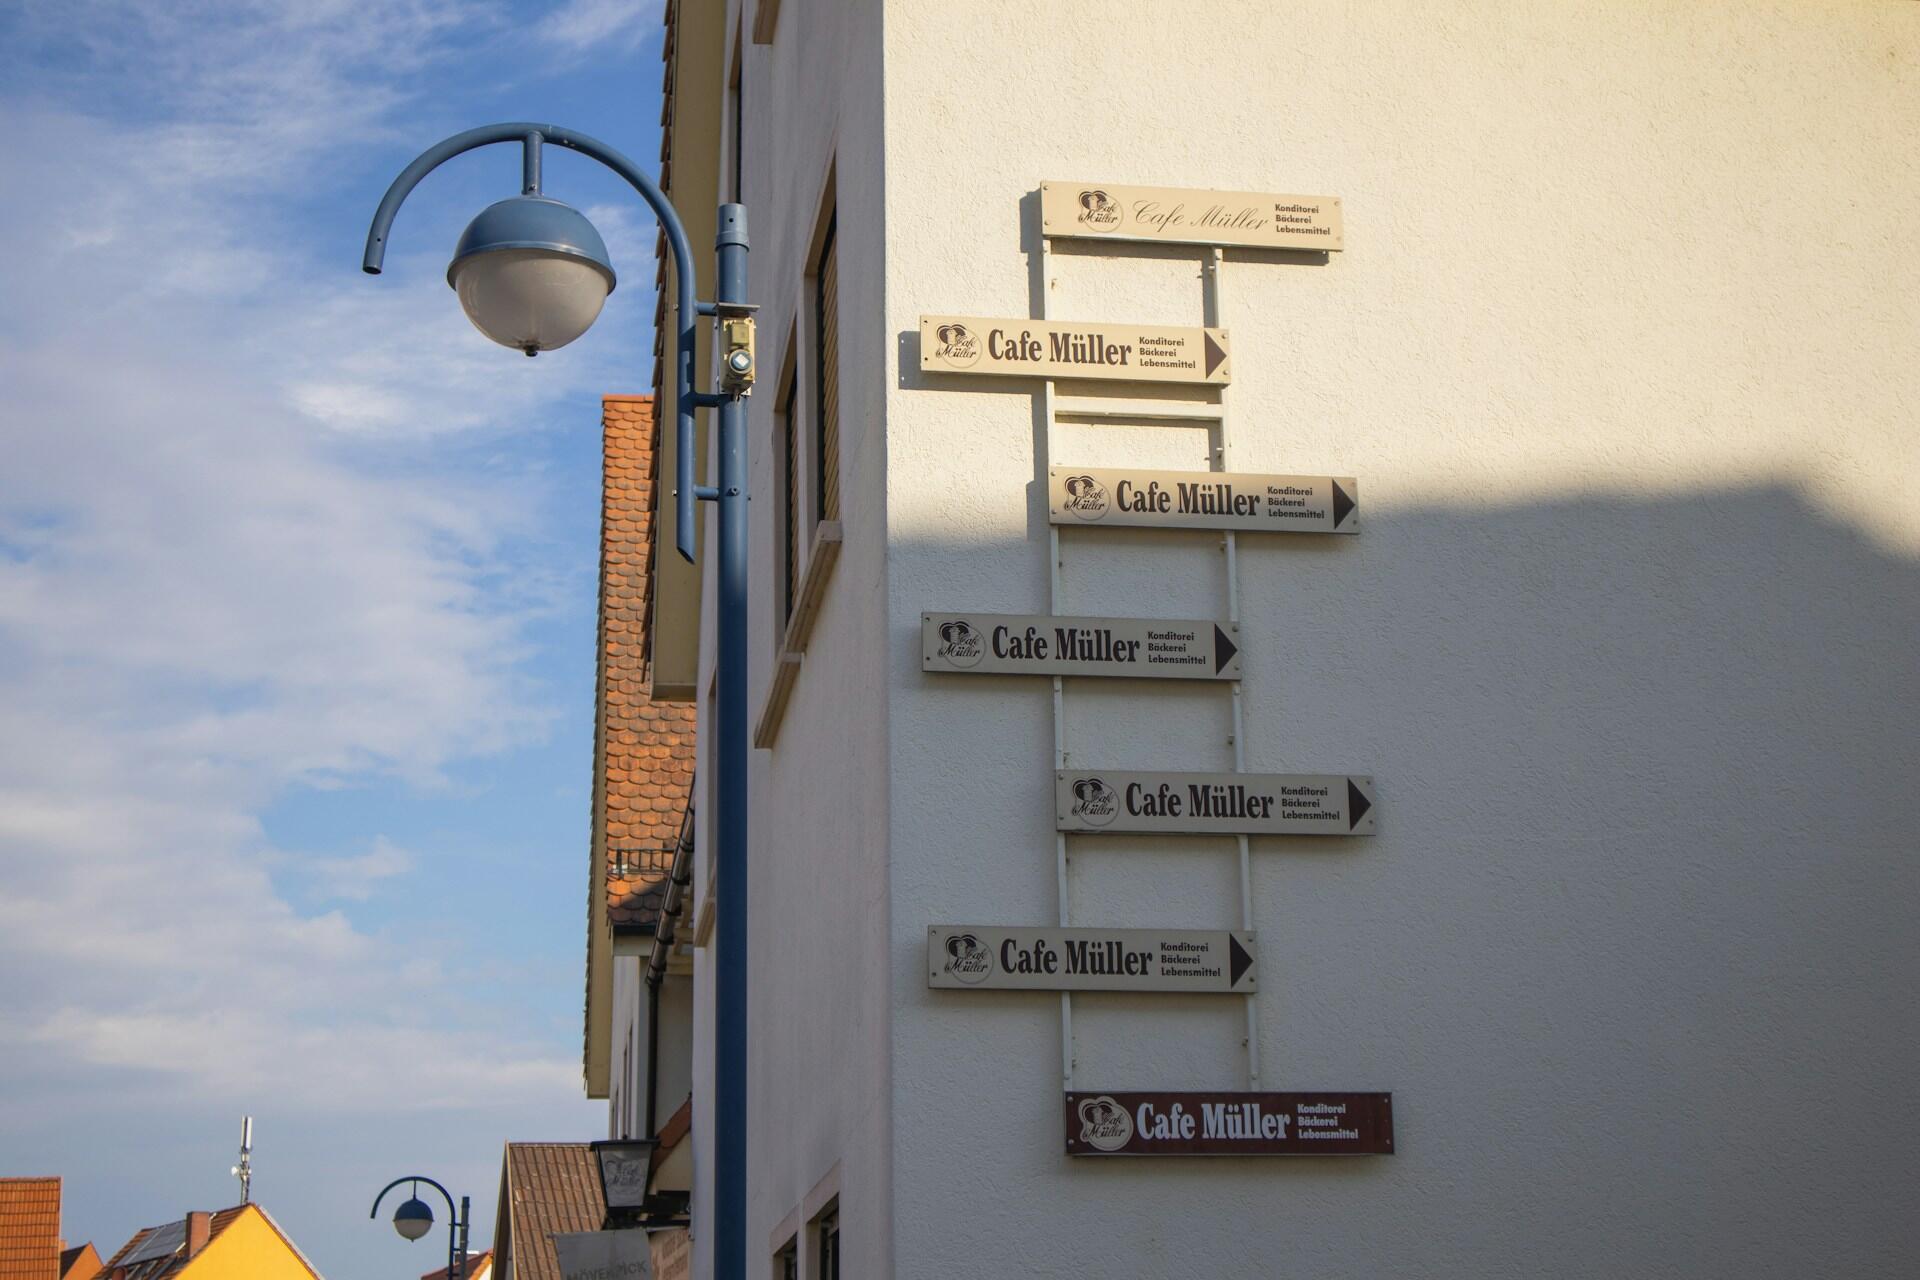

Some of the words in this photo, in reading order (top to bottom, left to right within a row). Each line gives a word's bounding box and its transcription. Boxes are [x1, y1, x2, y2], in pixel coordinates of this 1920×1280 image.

[1275, 204, 1319, 213] Konditorei
[1078, 209, 1118, 224] Müller
[1133, 200, 1184, 232] Cafe
[1190, 206, 1270, 230] Müller
[1275, 215, 1312, 224] Bäckerei
[1276, 226, 1331, 235] Lebensmittel
[1139, 336, 1184, 346] Konditorei
[936, 344, 977, 359] Müller
[988, 329, 1042, 361] Cafe
[1049, 332, 1132, 365] Müller
[1140, 348, 1176, 357] Bäckerei
[1140, 359, 1196, 369] Lebensmittel
[1267, 486, 1313, 496] Konditorei
[1117, 480, 1171, 513] Cafe
[1177, 482, 1260, 516] Müller
[1268, 497, 1305, 507] Bäckerei
[1064, 496, 1105, 511] Müller
[1269, 509, 1324, 519] Lebensmittel
[1148, 631, 1194, 641] Konditorei
[993, 626, 1048, 659] Cafe
[1055, 628, 1140, 662] Müller
[1148, 643, 1186, 653] Bäckerei
[938, 642, 980, 658] Müller
[1148, 654, 1206, 665] Lebensmittel
[1281, 787, 1327, 797] Konditorei
[1126, 783, 1182, 816] Cafe
[1188, 784, 1273, 818] Müller
[1282, 799, 1320, 808] Bäckerei
[1072, 801, 1114, 816] Müller
[1282, 810, 1340, 821] Lebensmittel
[1161, 942, 1208, 952] Konditorei
[1001, 939, 1058, 974] Cafe
[1065, 940, 1152, 975] Müller
[1161, 955, 1200, 965] Bäckerei
[945, 957, 988, 973] Müller
[1161, 967, 1220, 977] Lebensmittel
[1298, 1104, 1346, 1114] Konditorei
[1137, 1102, 1195, 1140] Cafe
[1202, 1103, 1290, 1139] Müller
[1298, 1116, 1338, 1126] Bäckerei
[1082, 1122, 1126, 1138] Müller
[1299, 1128, 1359, 1139] Lebensmittel
